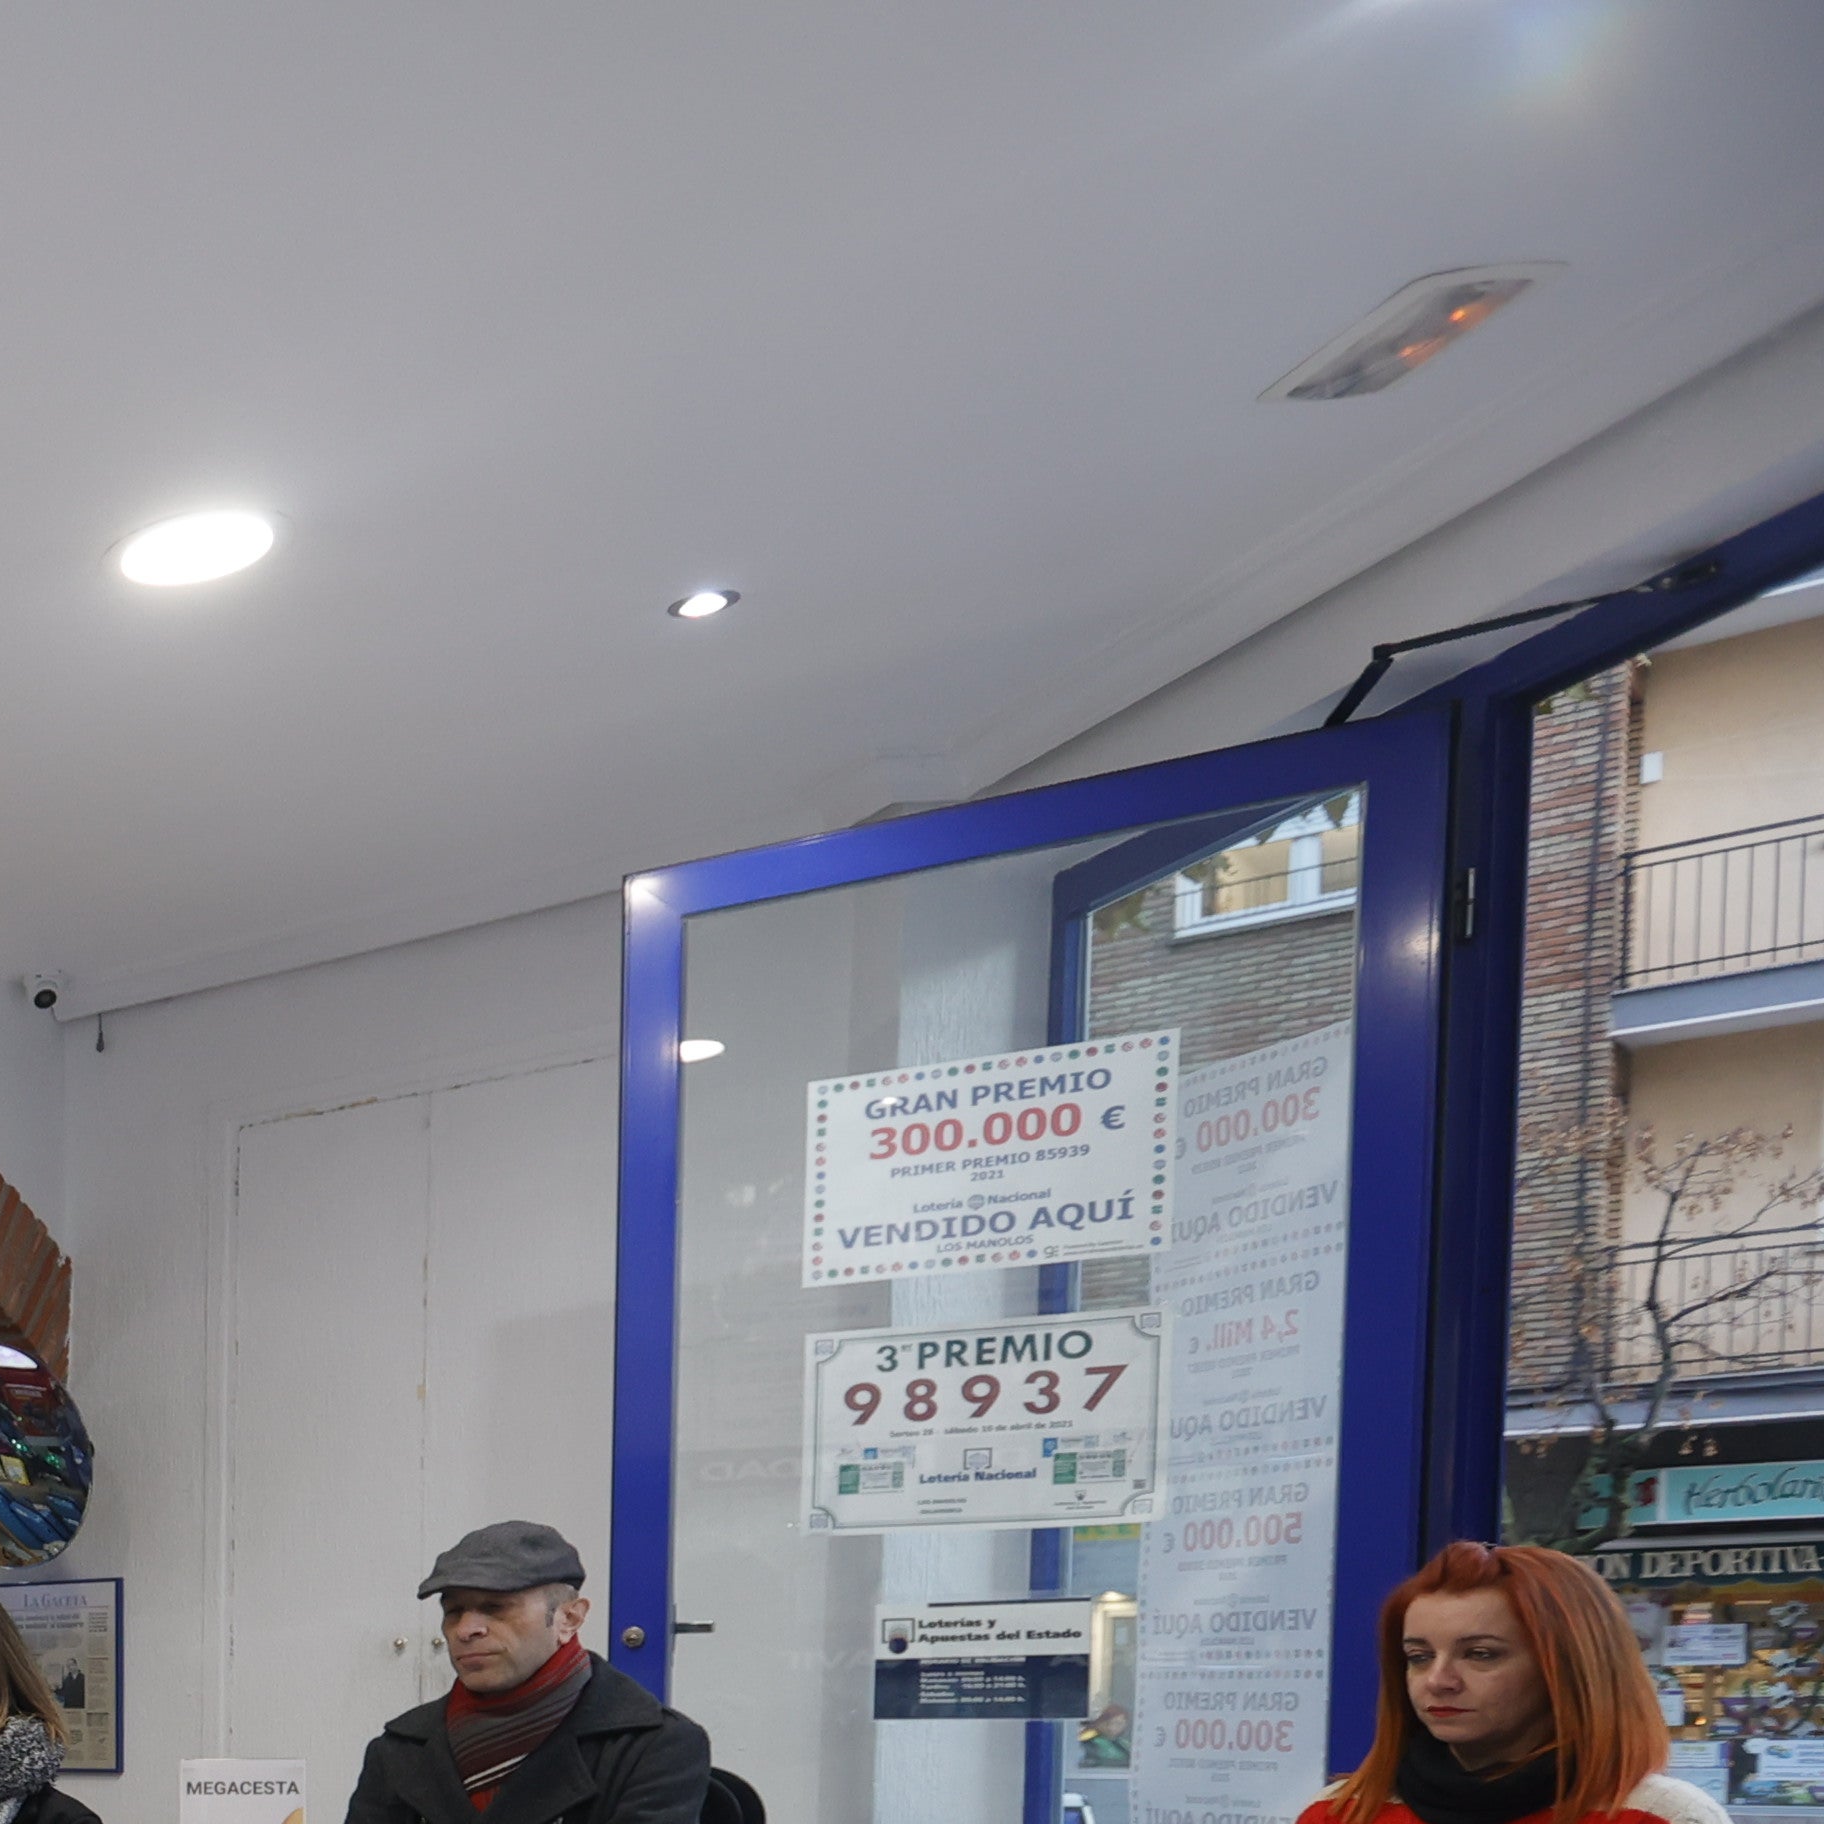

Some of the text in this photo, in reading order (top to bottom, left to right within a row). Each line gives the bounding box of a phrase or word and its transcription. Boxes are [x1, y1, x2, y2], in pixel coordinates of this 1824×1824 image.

[864, 1068, 1113, 1121] GRAN PREMIO
[868, 1102, 1127, 1160] 300.000 €
[889, 1144, 1091, 1179] PRIMER PREMIO 85939
[969, 1169, 1006, 1182] 2021
[987, 1188, 1052, 1205] Nacional
[837, 1210, 1017, 1250] VENDIDO
[1028, 1188, 1136, 1232] AQUÍ
[936, 1234, 1035, 1254] LOS MANOLOS
[917, 1329, 1094, 1370] PREMIO
[974, 1466, 1037, 1482] Nacional
[987, 1618, 997, 1629] y
[918, 1628, 1082, 1645] Apuestas del Estado
[186, 1781, 300, 1796] MEGACESTA
